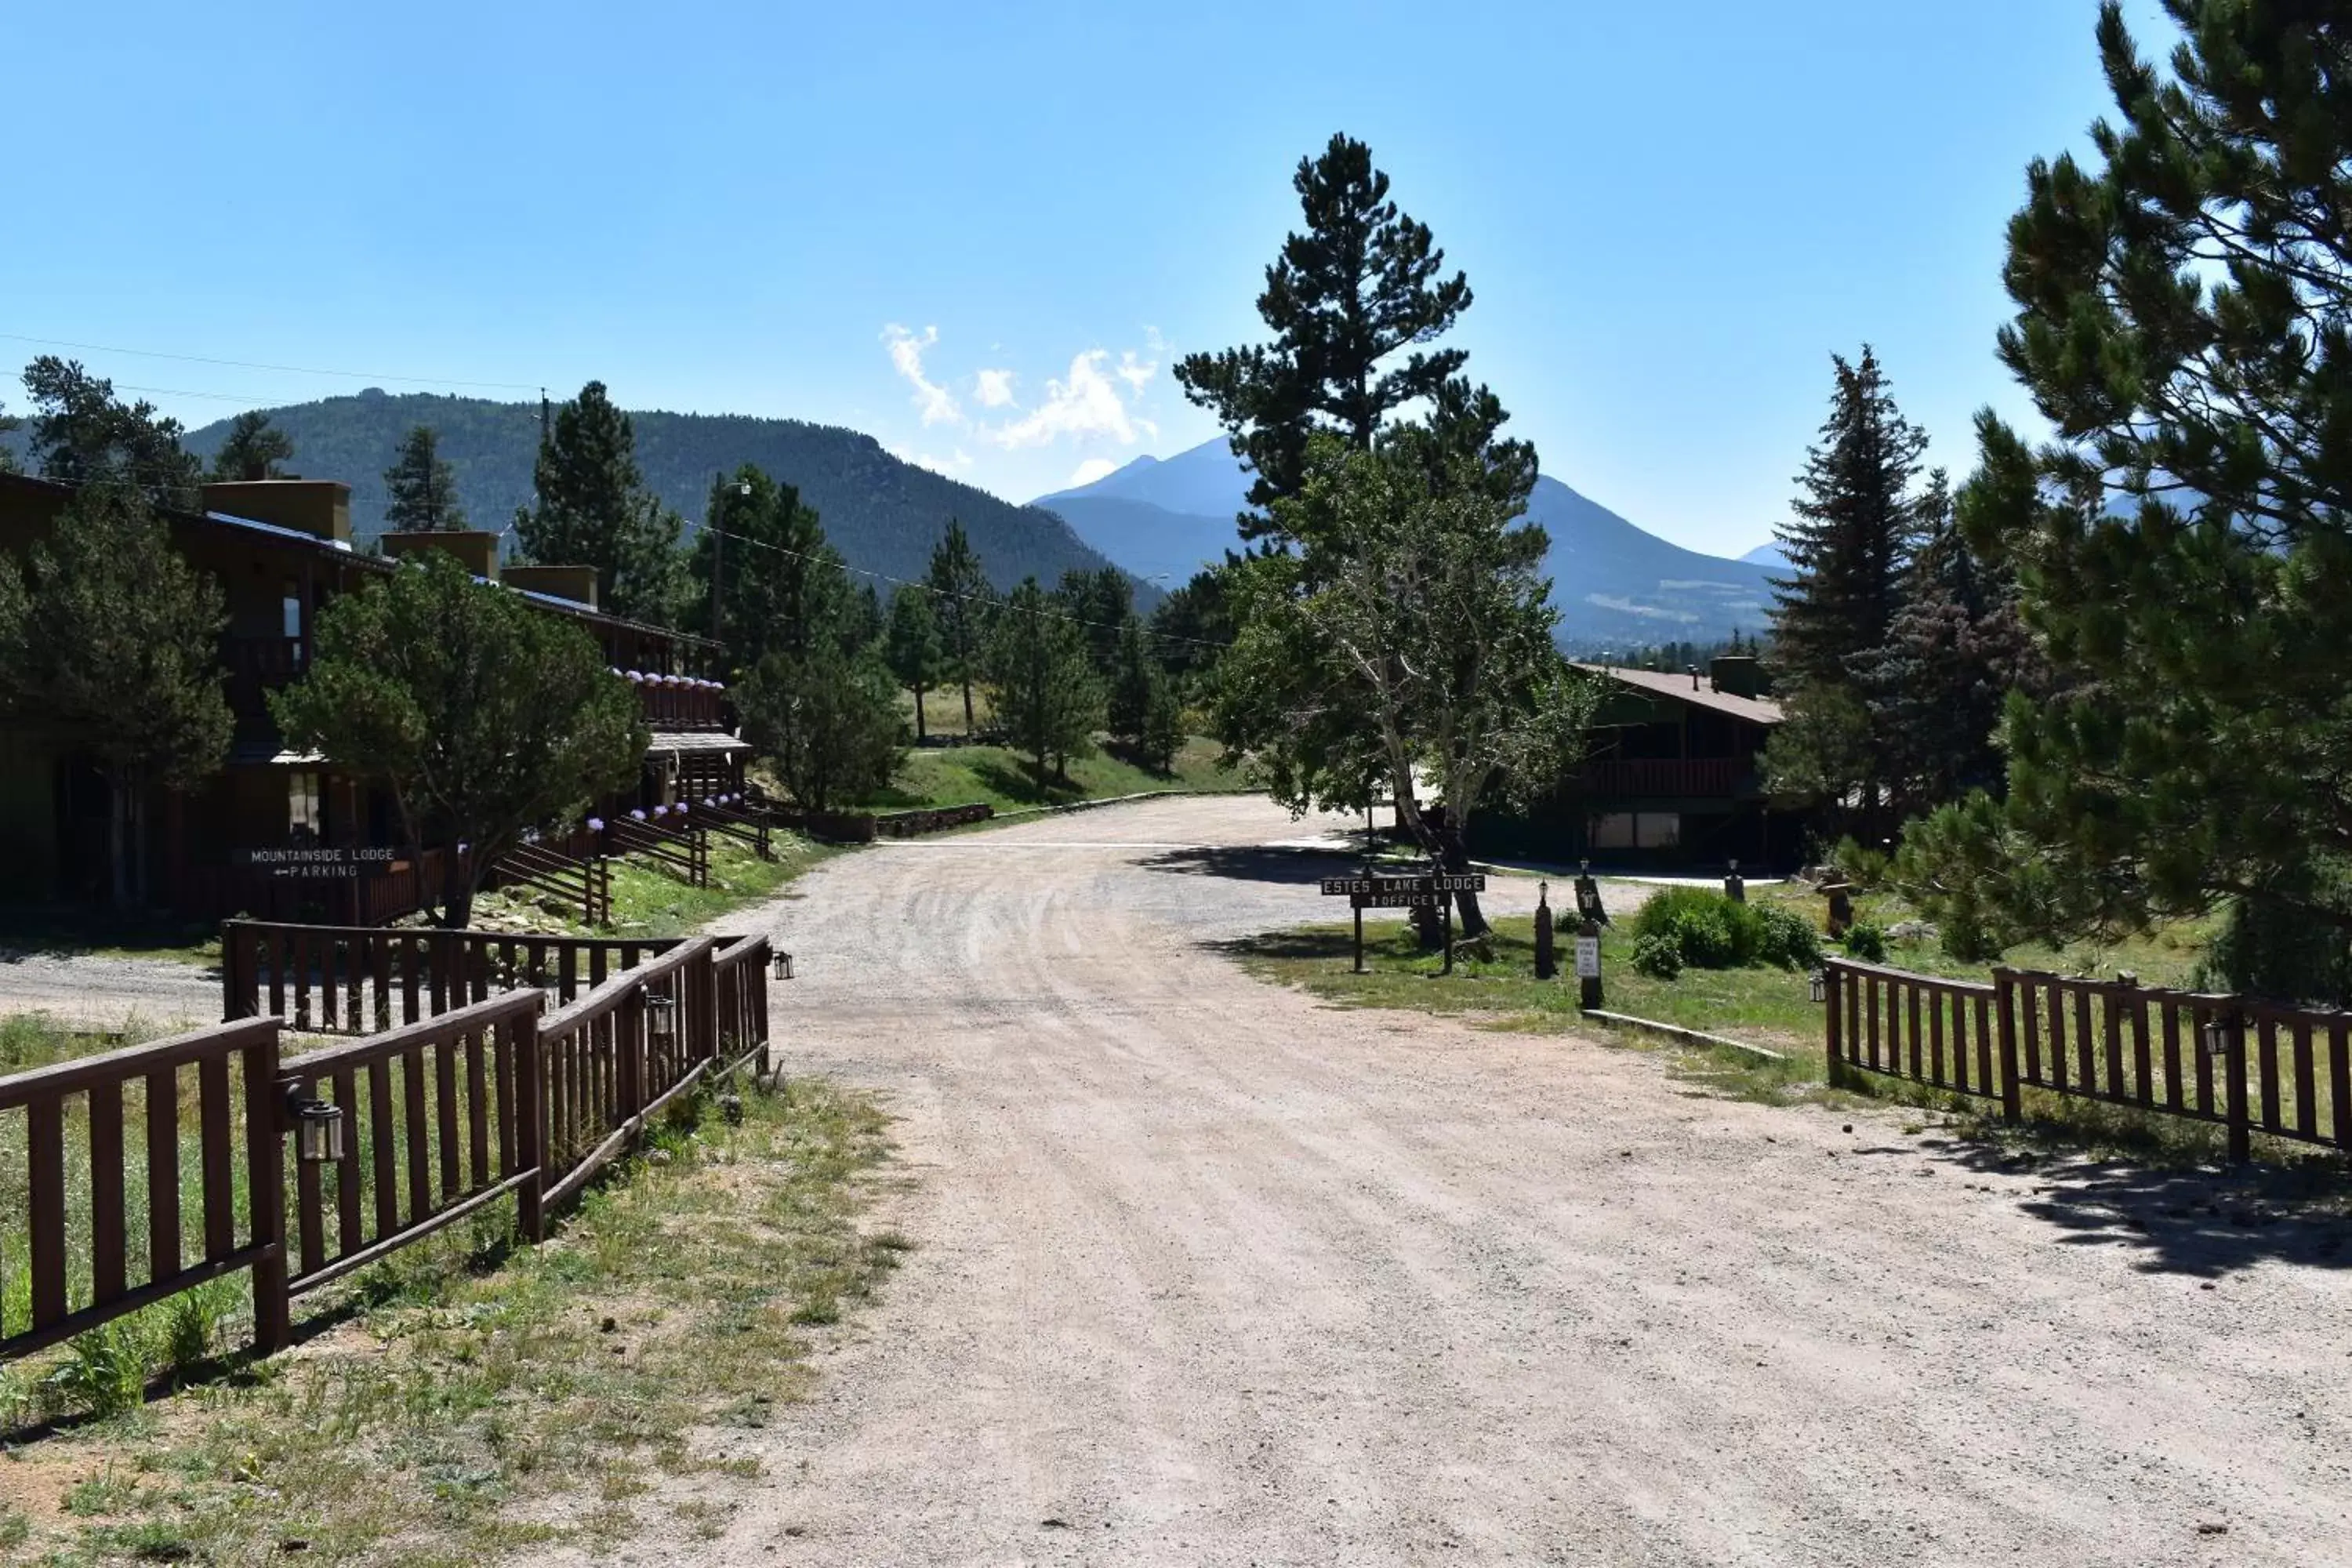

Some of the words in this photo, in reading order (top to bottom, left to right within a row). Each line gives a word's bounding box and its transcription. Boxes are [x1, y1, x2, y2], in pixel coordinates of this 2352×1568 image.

[252, 849, 343, 862] MOUNTAINSIDE
[353, 849, 394, 860] LODGE
[290, 866, 358, 877] PARKING
[1324, 880, 1370, 893] ESTES
[1384, 879, 1421, 891] LAKE
[1434, 877, 1481, 890] LODGE
[1381, 895, 1428, 906] OFFICE
